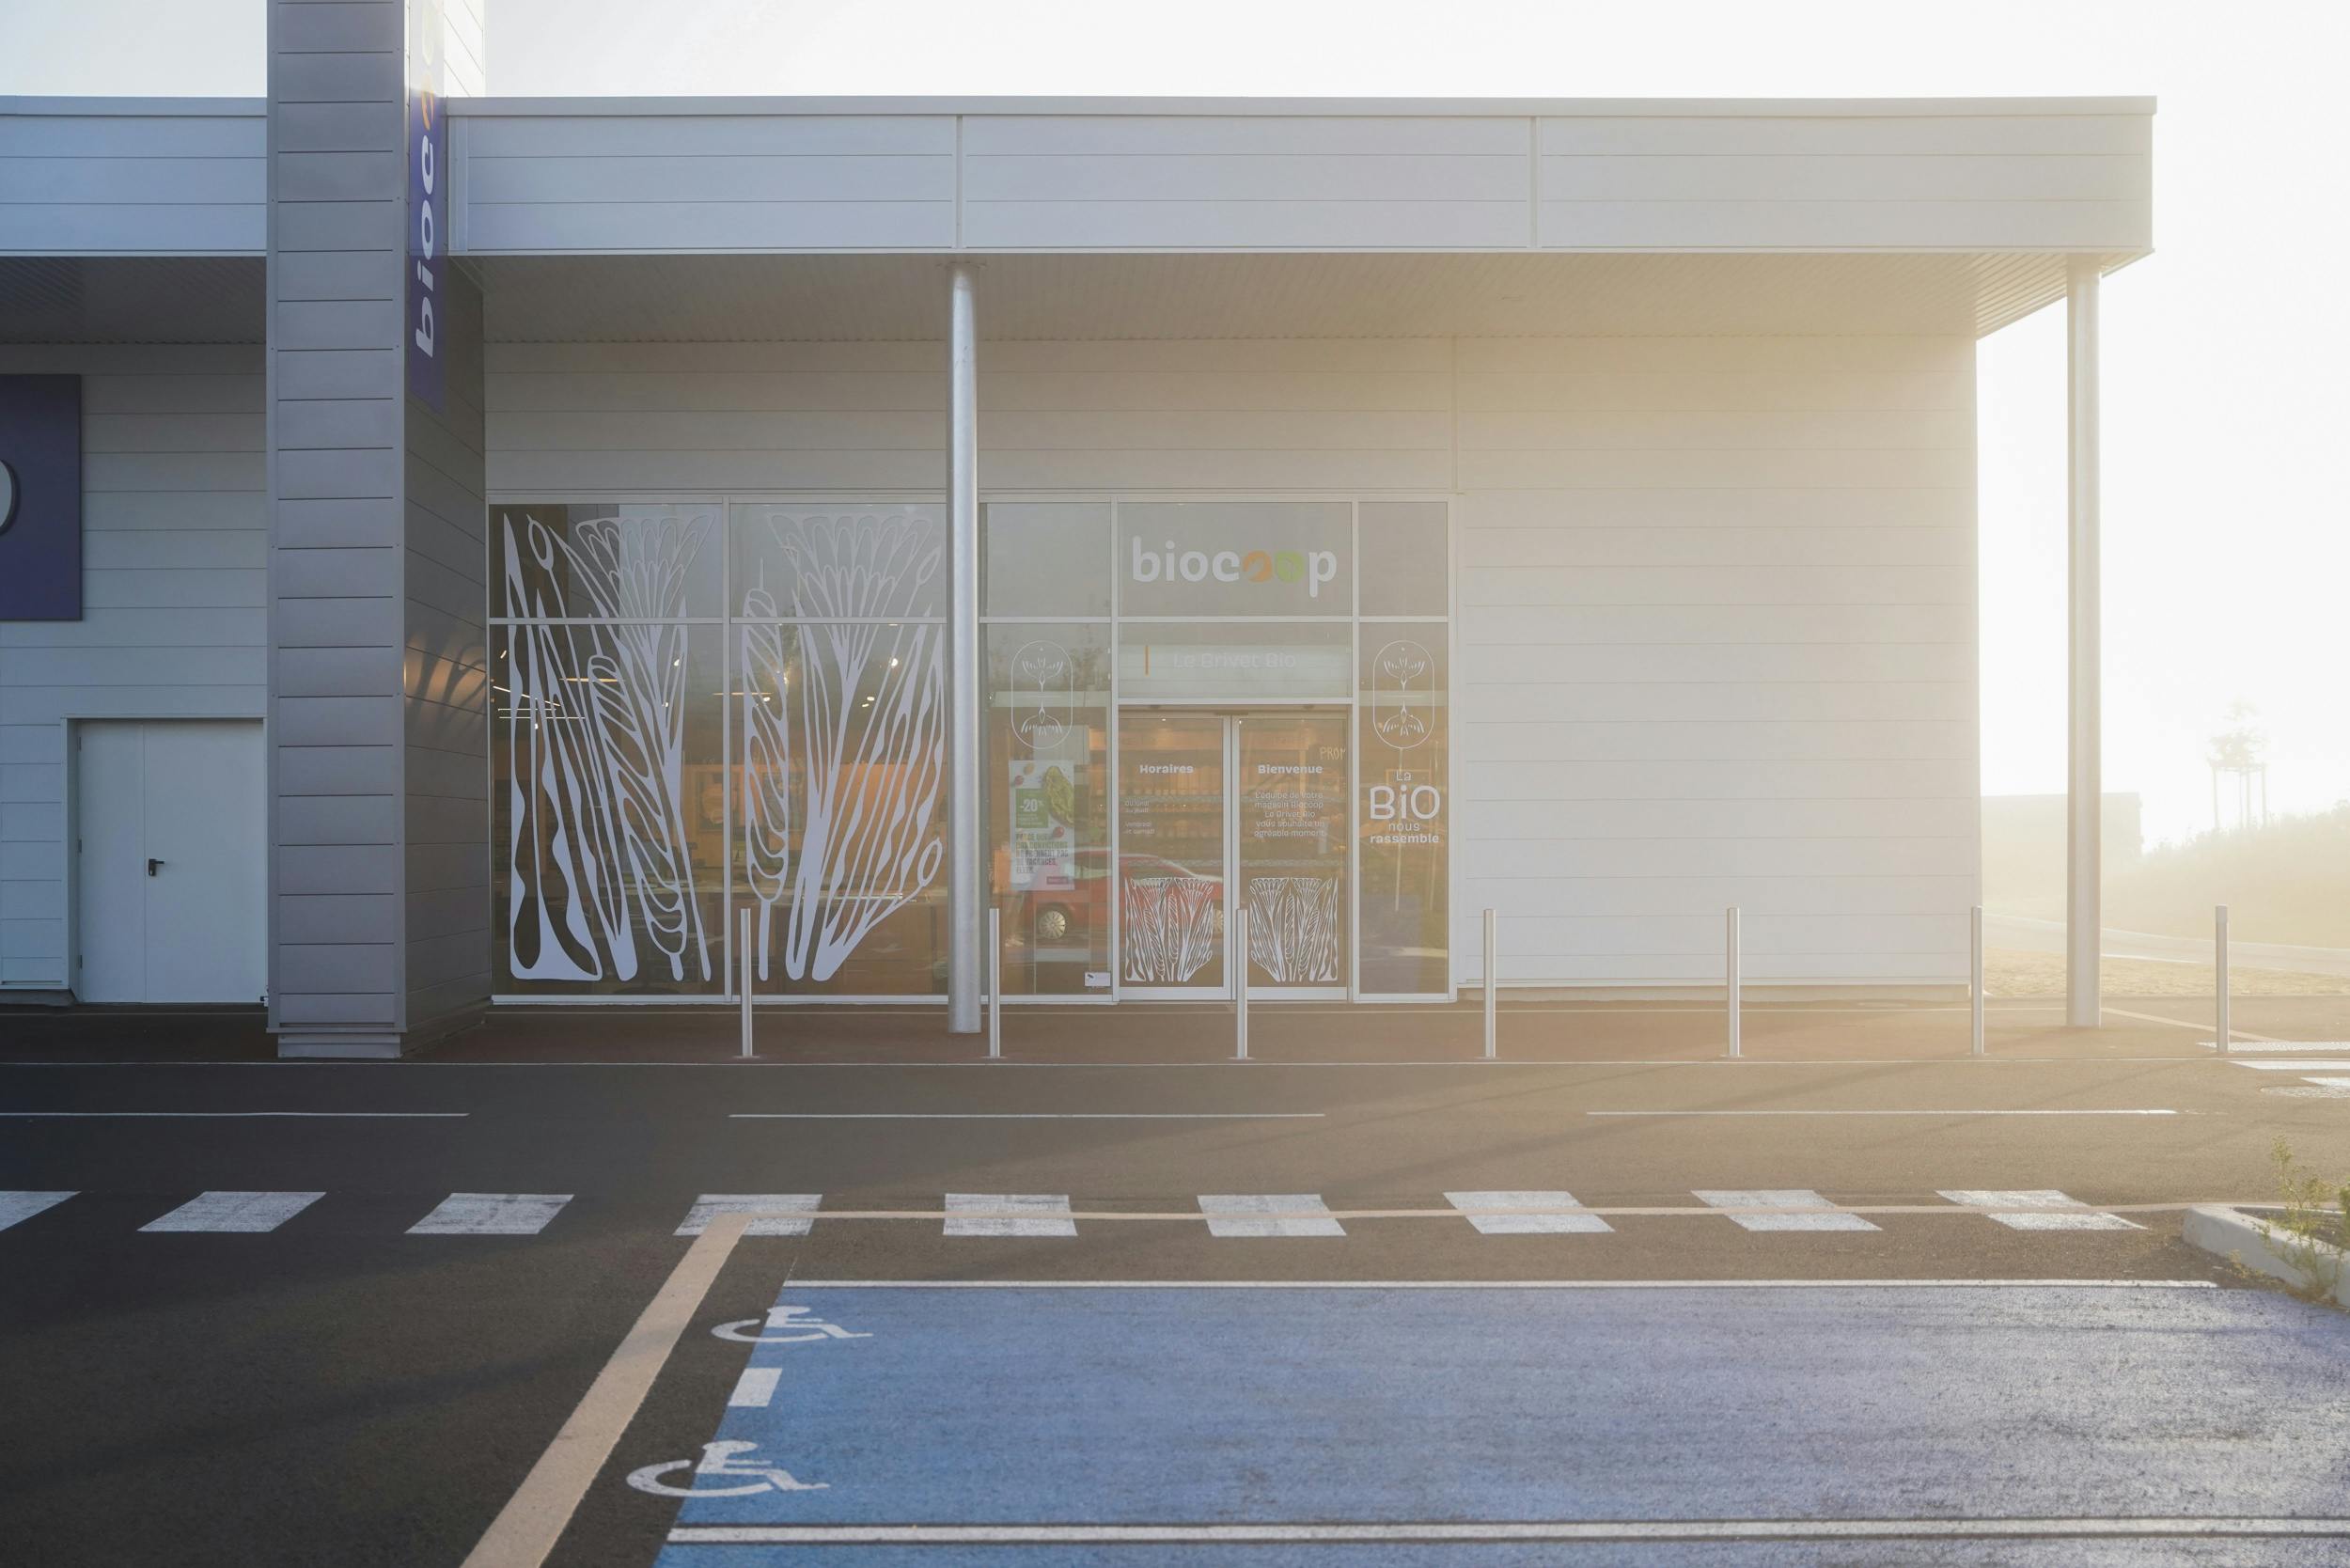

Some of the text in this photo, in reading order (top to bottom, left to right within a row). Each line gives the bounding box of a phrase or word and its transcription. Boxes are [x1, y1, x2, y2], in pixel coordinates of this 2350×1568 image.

[1132, 535, 1339, 599] biocoop
[1139, 763, 1194, 774] Horaires
[1258, 764, 1324, 774] Bienvenue
[1396, 770, 1412, 782] La
[1388, 823, 1421, 832] nous
[1370, 833, 1439, 843] rassemble
